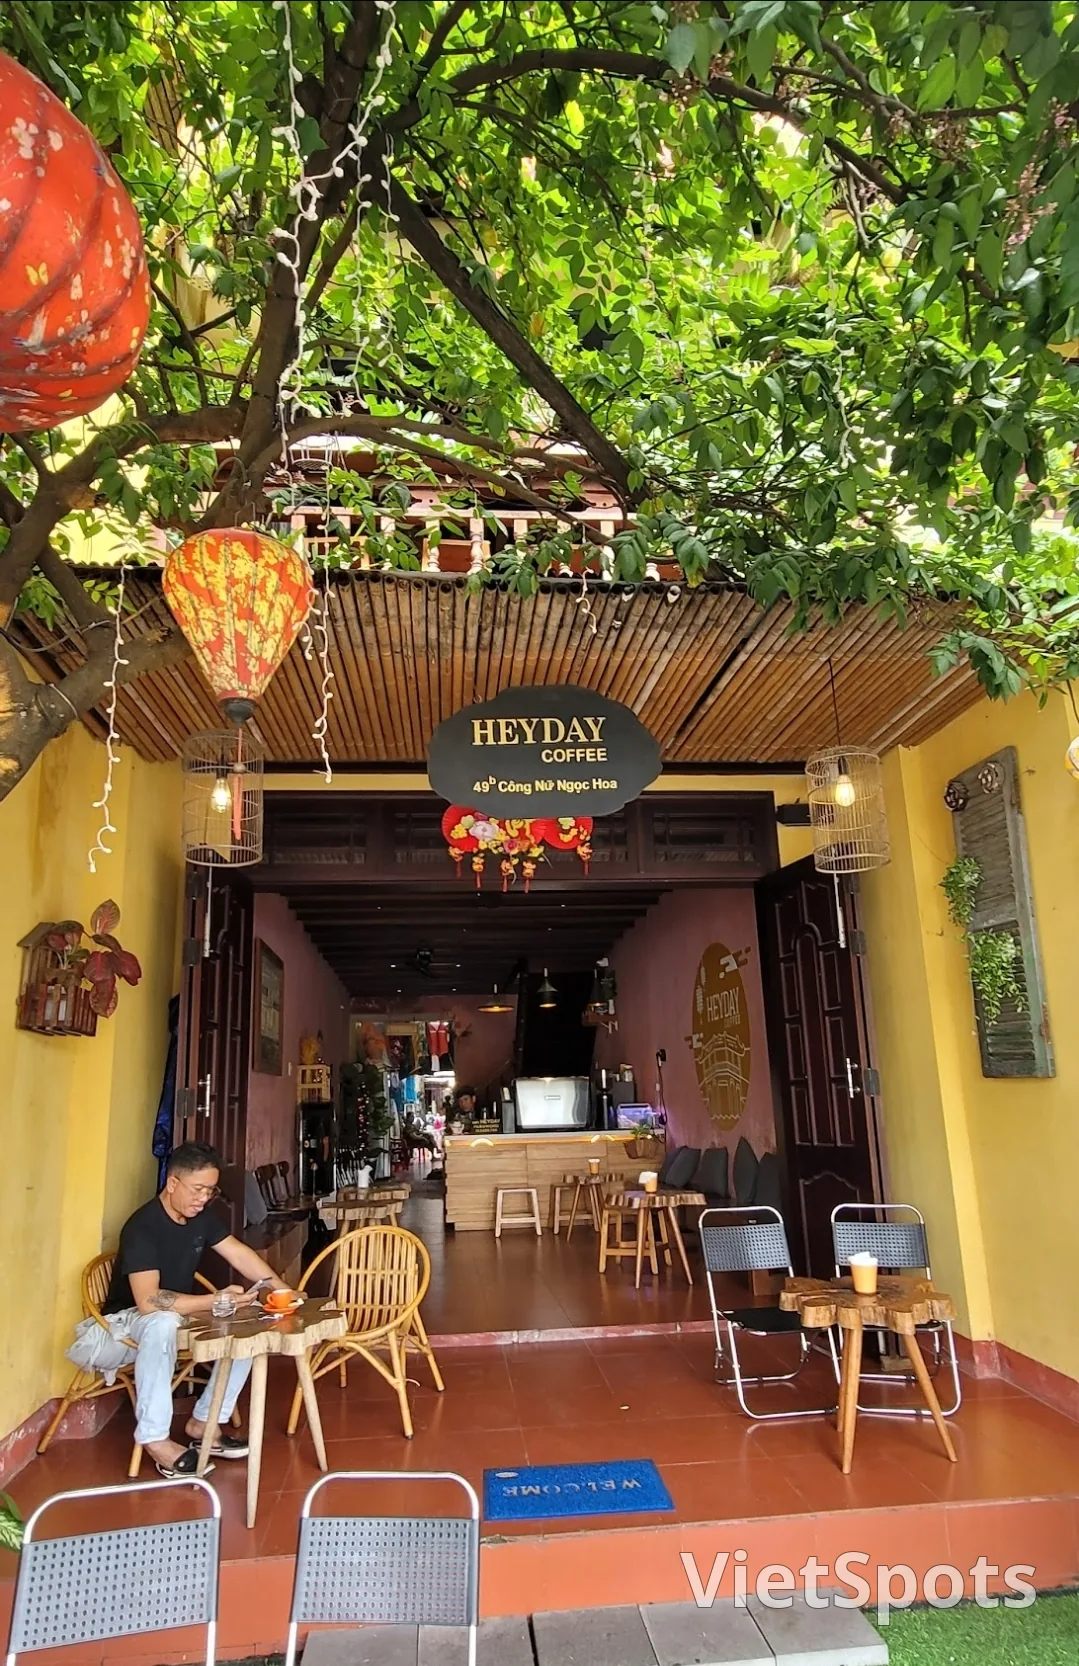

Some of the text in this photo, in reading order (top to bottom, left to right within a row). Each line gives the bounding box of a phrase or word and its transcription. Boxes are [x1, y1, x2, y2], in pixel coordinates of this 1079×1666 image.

[471, 716, 606, 745] HEYDAY
[541, 748, 608, 763] COFFEE
[498, 780, 532, 795] Công
[557, 779, 590, 794] Ngọc
[592, 778, 618, 790] Hoa
[706, 986, 739, 1022] HEYDAY
[502, 1478, 642, 1497] WELCOME
